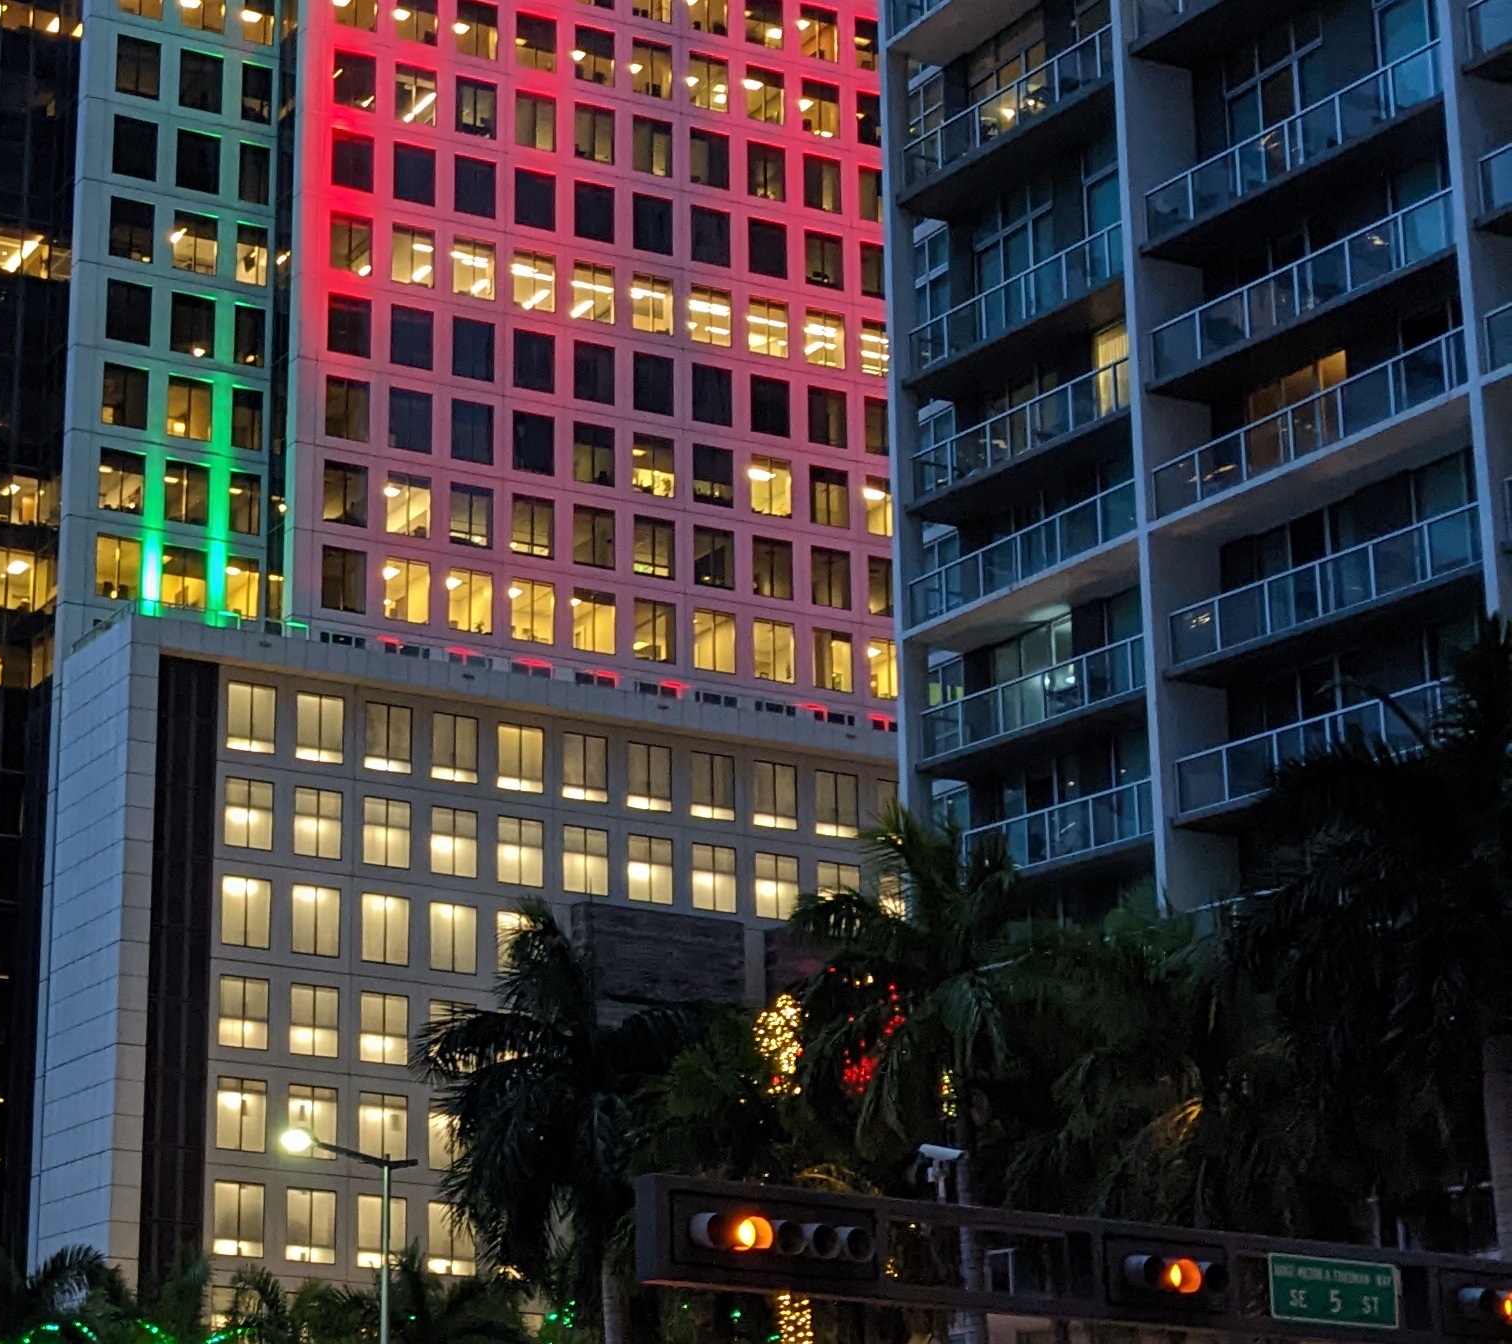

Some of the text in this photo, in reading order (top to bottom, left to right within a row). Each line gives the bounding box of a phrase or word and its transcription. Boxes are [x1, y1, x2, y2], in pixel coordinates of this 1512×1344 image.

[1289, 1289, 1380, 1315] SE 5 ST
